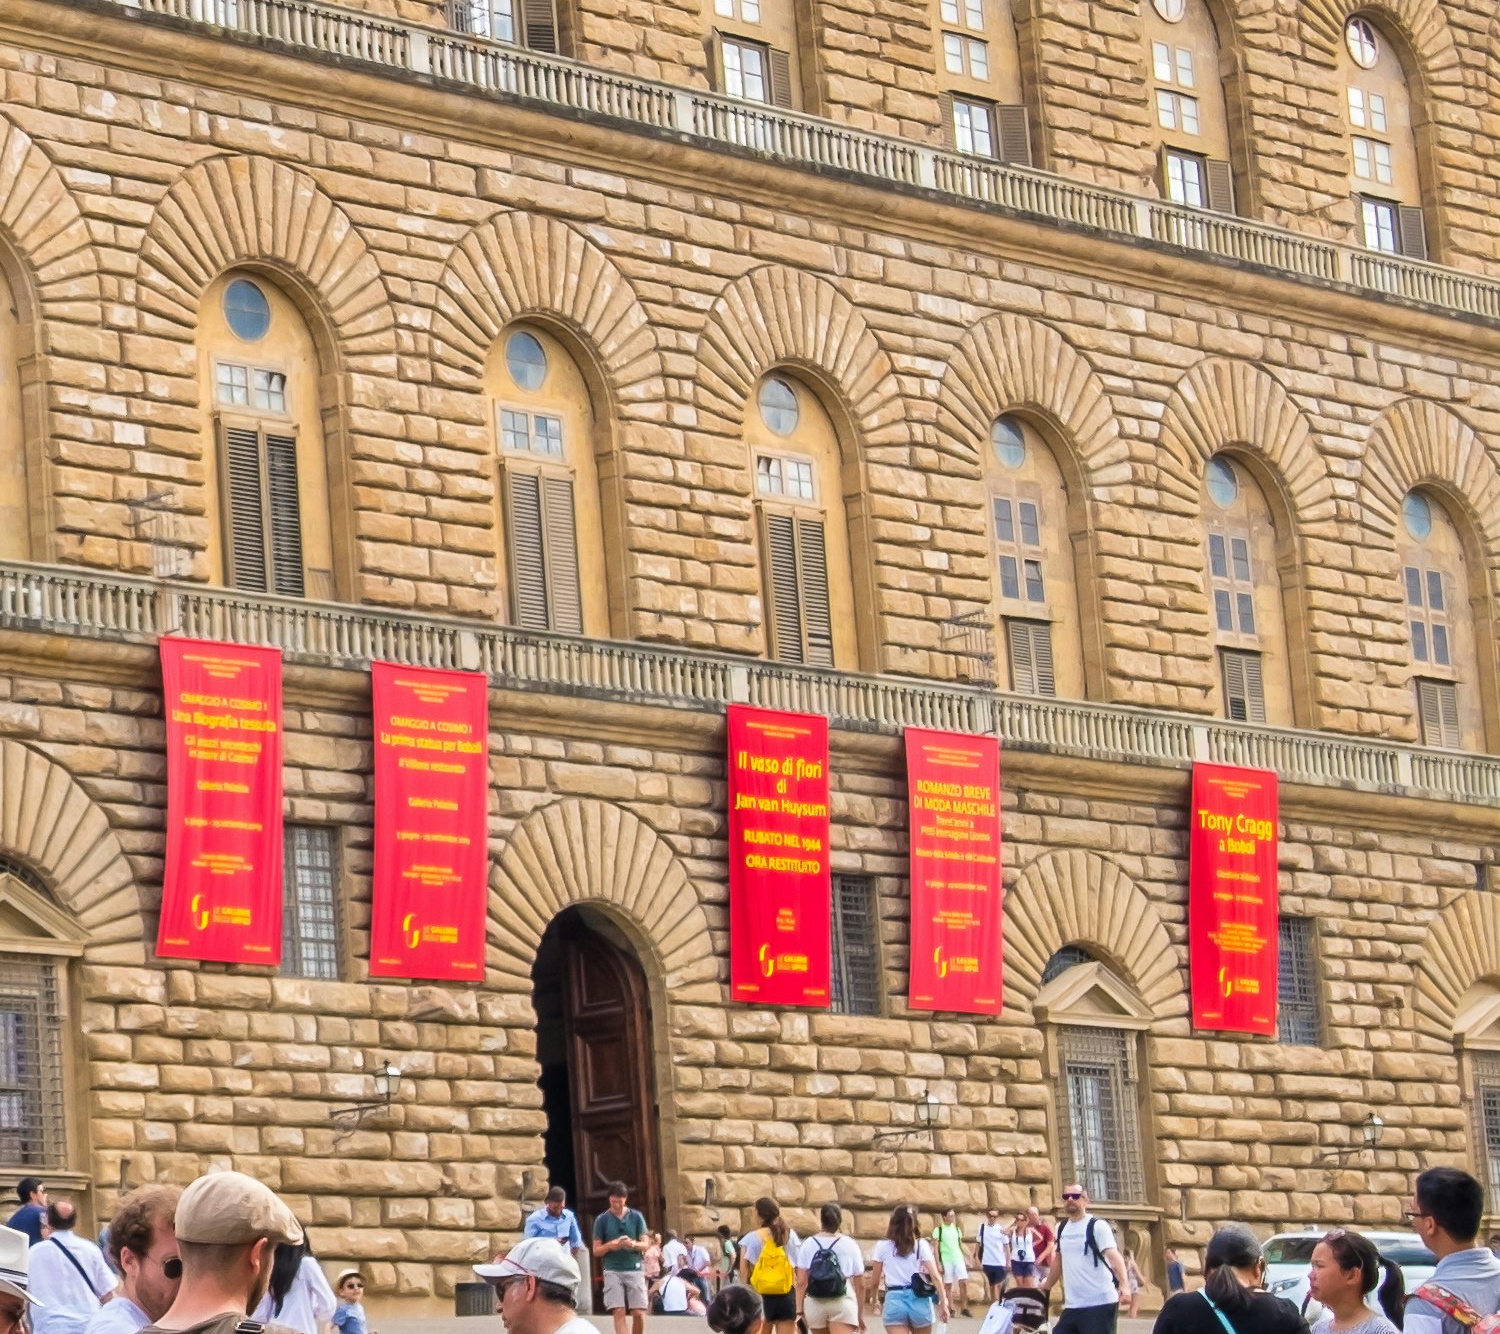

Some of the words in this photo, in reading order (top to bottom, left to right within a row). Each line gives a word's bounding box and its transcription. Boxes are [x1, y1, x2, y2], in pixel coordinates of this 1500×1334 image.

[172, 709, 192, 723] Una
[738, 751, 747, 769] Il
[750, 757, 779, 774] vaso
[782, 757, 793, 776] di
[796, 758, 822, 781] fiori
[776, 779, 787, 794] di
[917, 779, 962, 797] ROMANZO
[963, 785, 991, 800] BREVE
[735, 793, 756, 810] Jan
[758, 798, 778, 812] van
[781, 798, 826, 818] Huysum
[914, 795, 922, 809] DI
[924, 797, 951, 813] MODA
[953, 801, 995, 817] MASCHILE
[1198, 810, 1233, 836] Tony
[1236, 813, 1272, 842] Cragg
[744, 829, 782, 846] RUBATO
[784, 834, 800, 848] NEL
[1219, 839, 1225, 852] a
[1227, 838, 1255, 855] Boboli
[745, 855, 767, 869] ORA
[768, 857, 820, 874] RESTITUITO
